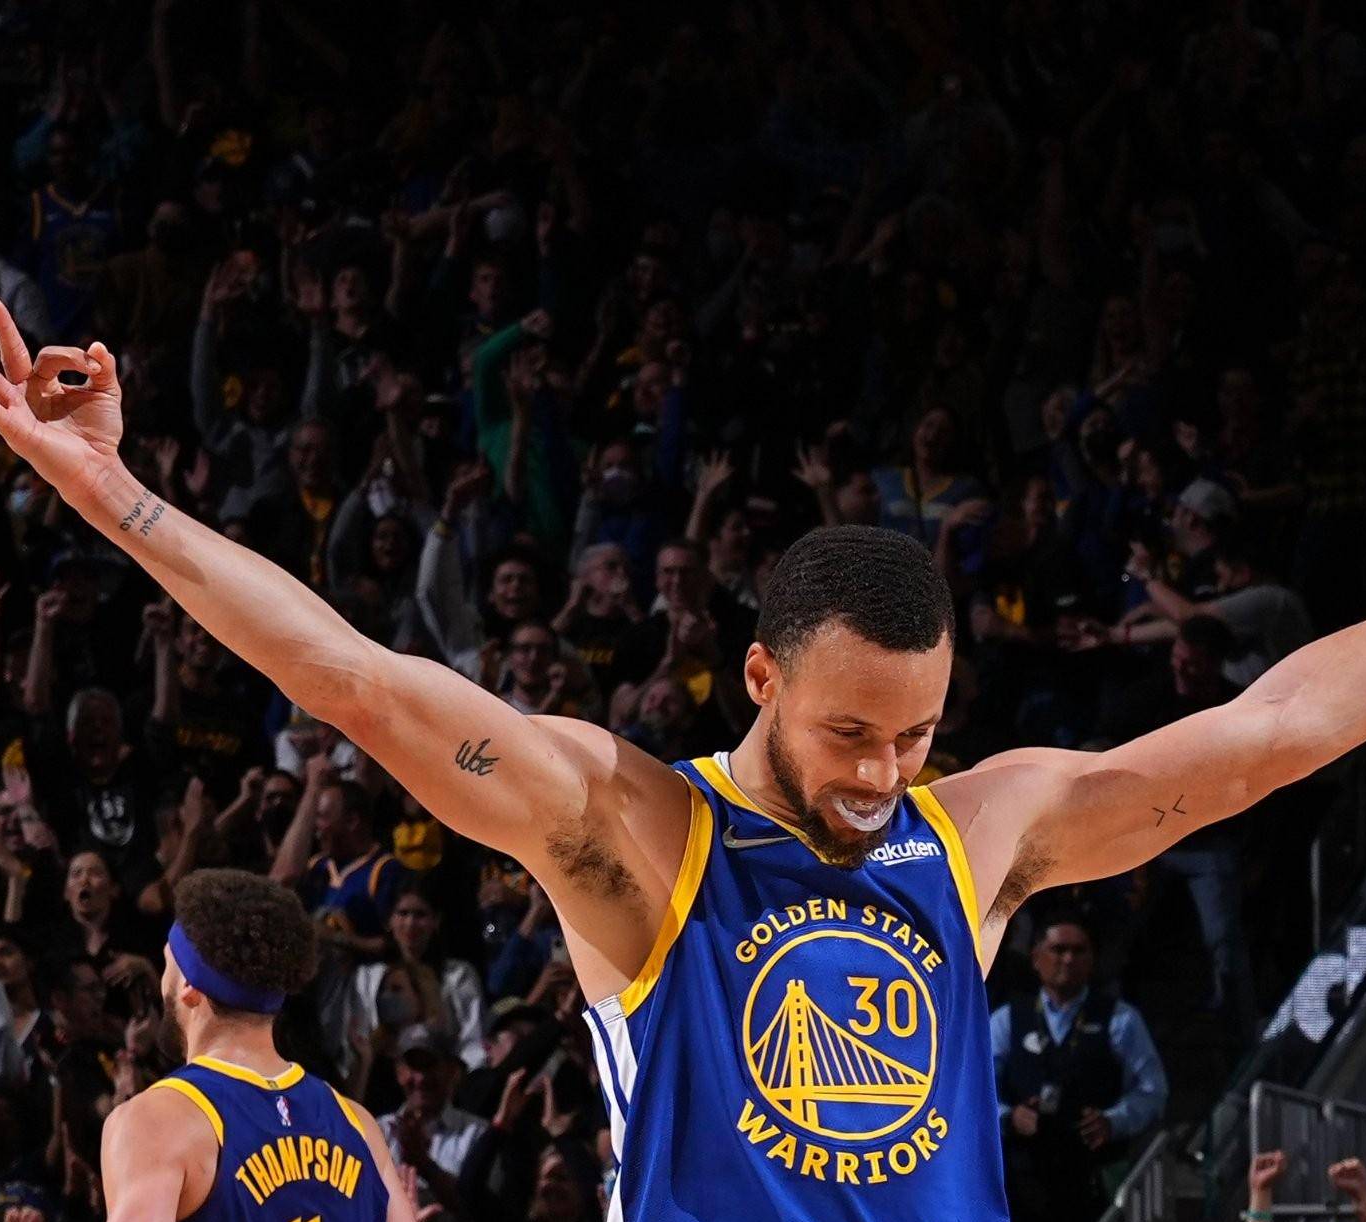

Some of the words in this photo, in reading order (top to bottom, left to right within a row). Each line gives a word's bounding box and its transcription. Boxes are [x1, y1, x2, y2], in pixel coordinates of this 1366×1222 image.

[865, 838, 942, 862] akuten
[735, 898, 846, 965] GOLDEN
[861, 904, 945, 974] STATE
[847, 976, 919, 1038] 30
[234, 1135, 363, 1206] THOMPSON
[736, 1098, 949, 1186] WARRIORS
